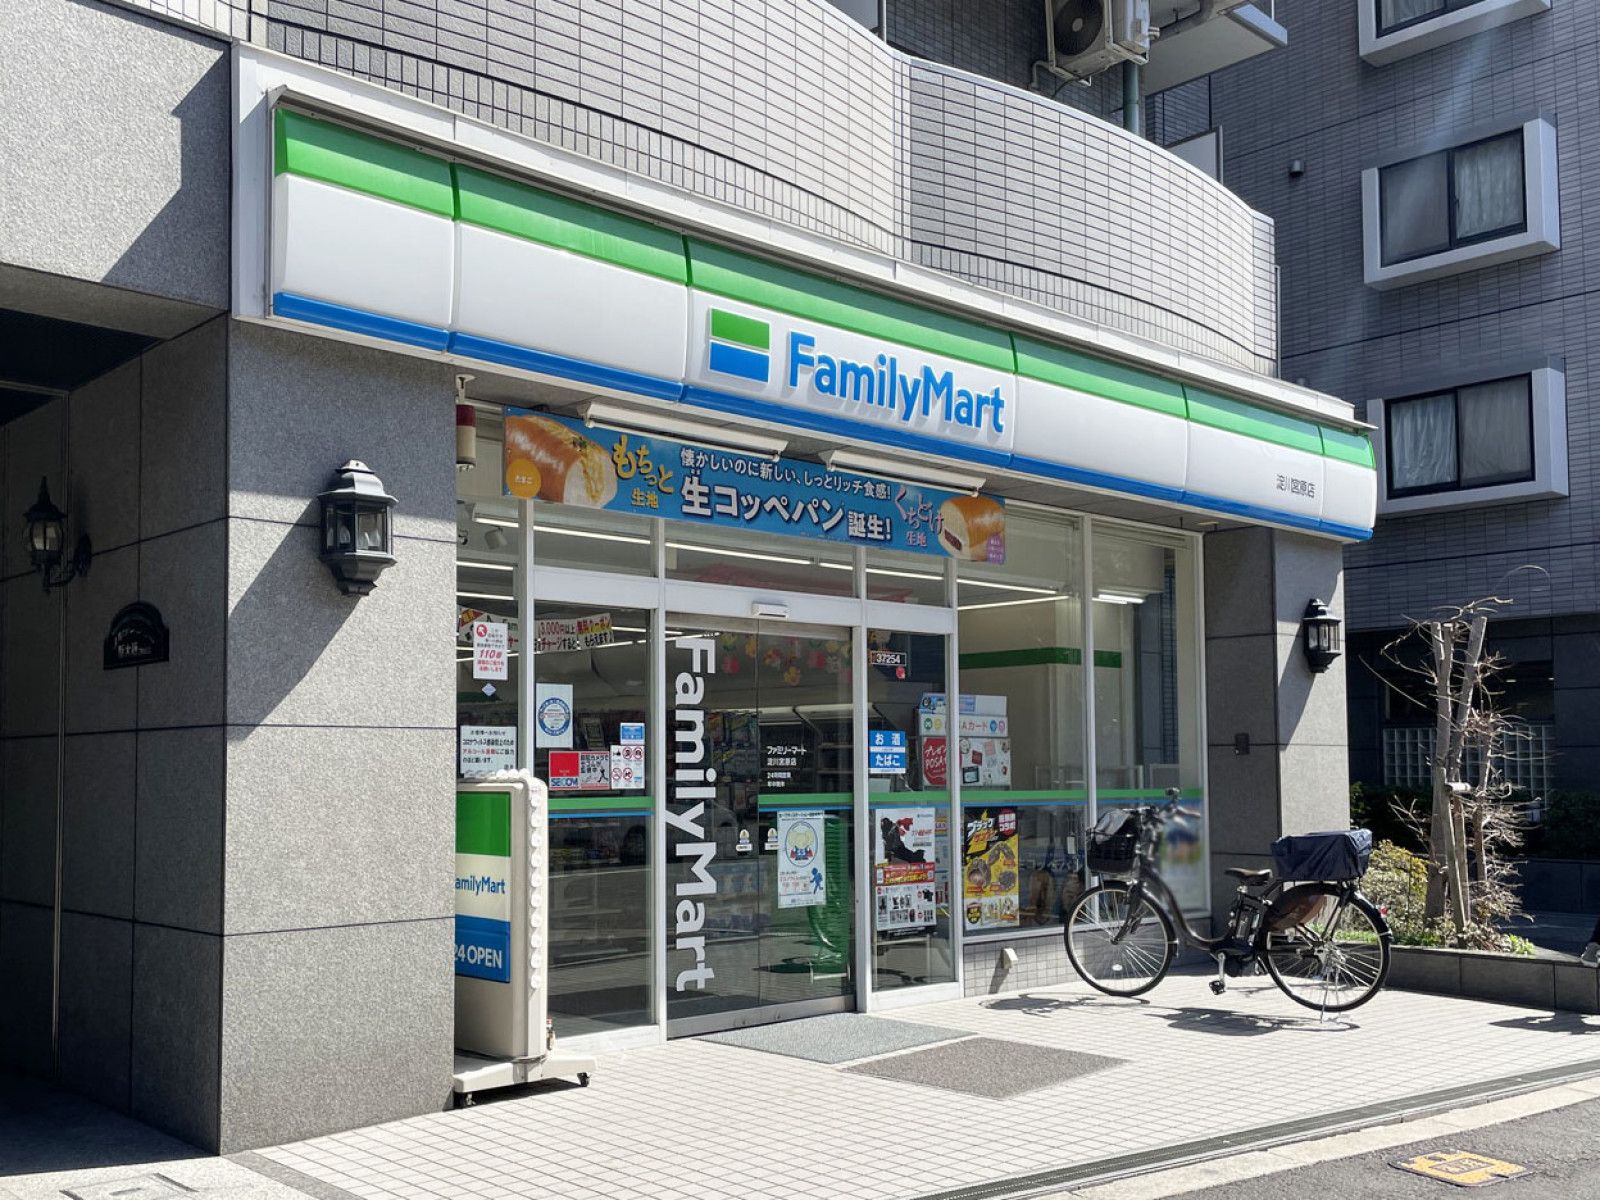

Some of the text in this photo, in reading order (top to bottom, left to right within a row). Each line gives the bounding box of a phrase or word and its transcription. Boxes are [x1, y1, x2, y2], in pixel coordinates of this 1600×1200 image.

[789, 331, 1005, 433] FamilyMart
[612, 435, 675, 493] もちっと
[631, 489, 659, 509] 生地
[767, 744, 807, 756] ファミリーマート
[875, 753, 902, 767] たばこ
[551, 777, 579, 787] SECOM
[665, 639, 718, 992] FamilyMart
[455, 874, 506, 896] amilyMart
[467, 944, 503, 969] OPEN
